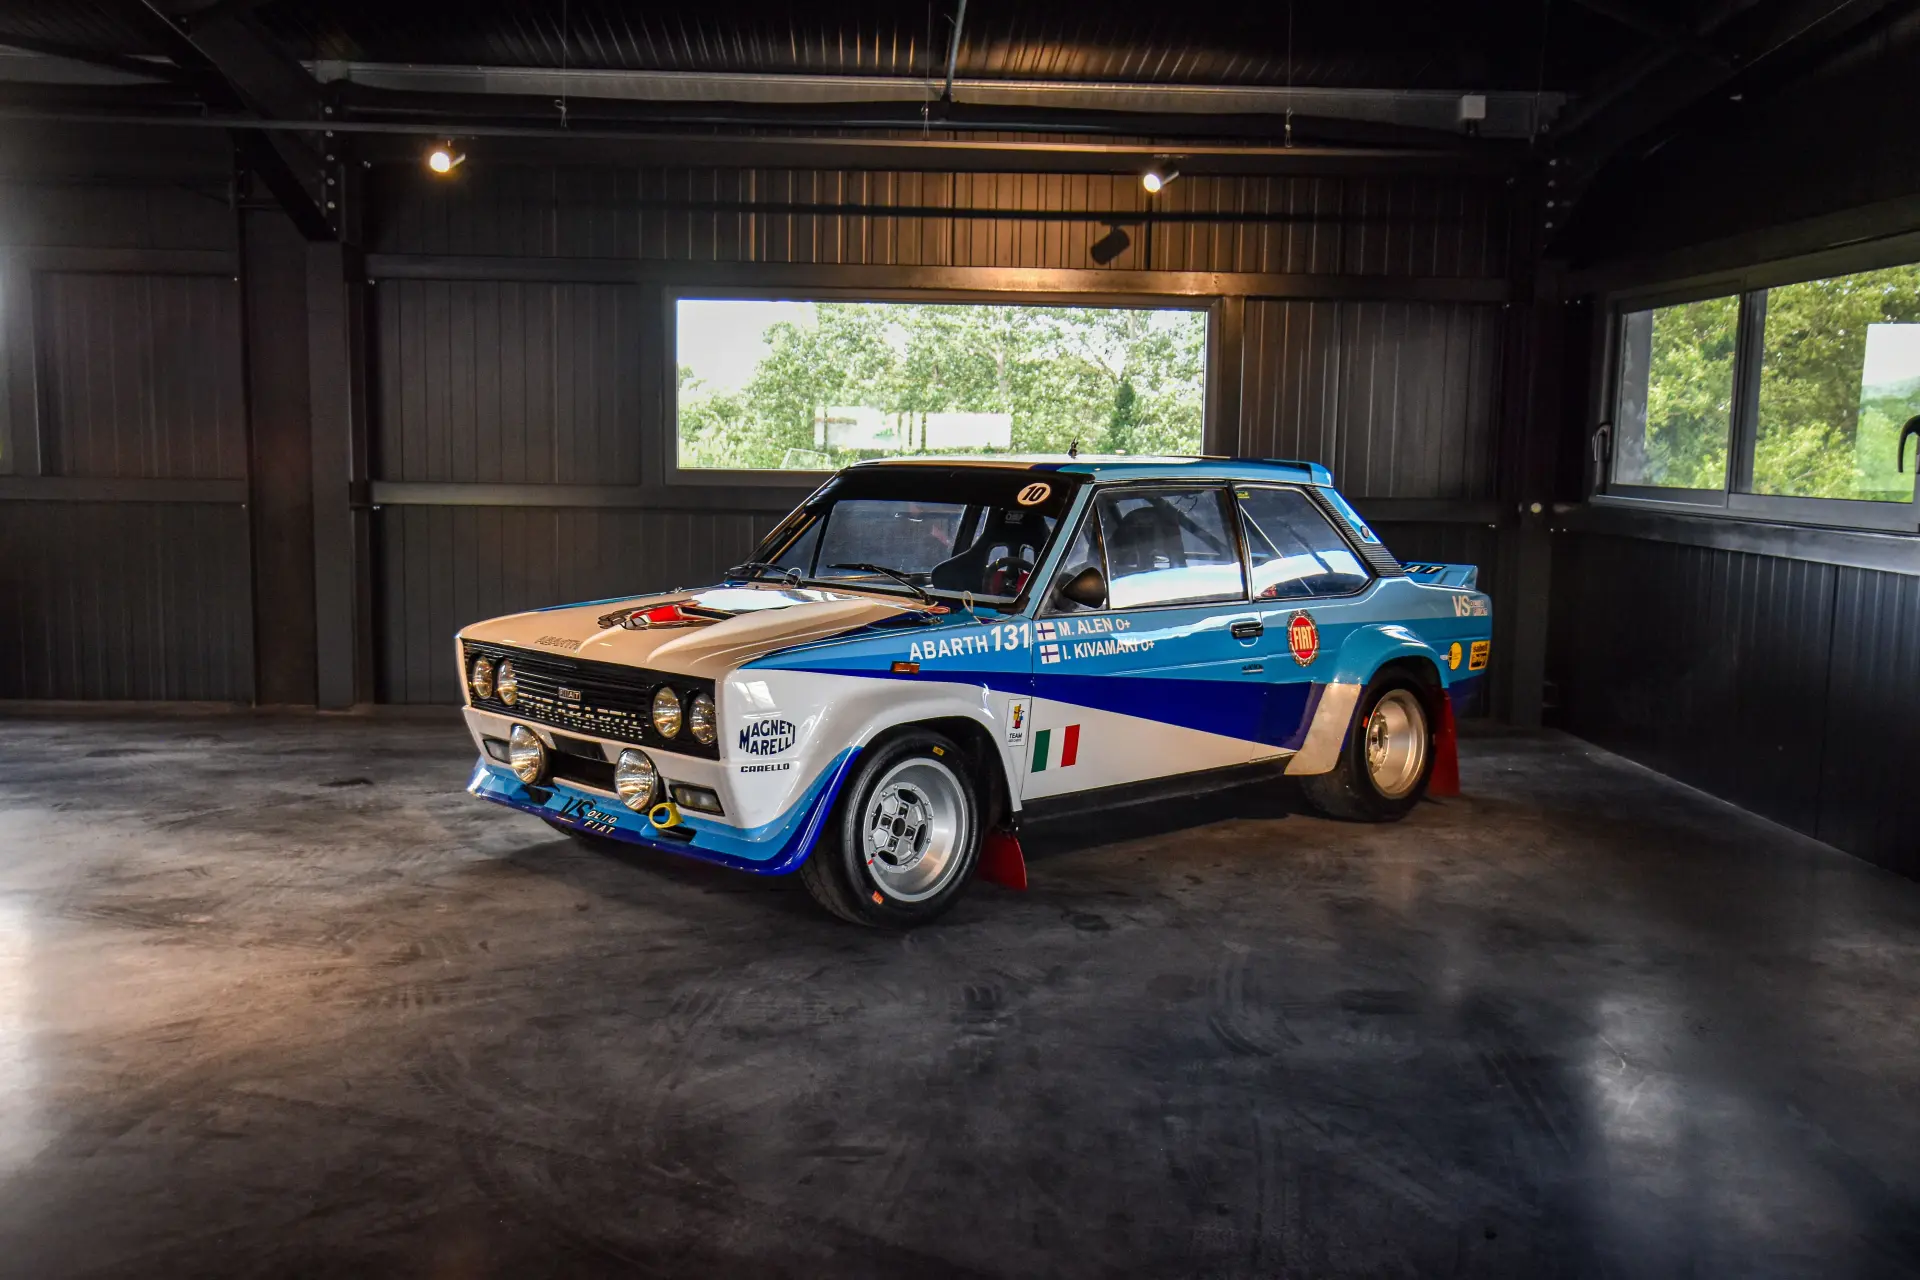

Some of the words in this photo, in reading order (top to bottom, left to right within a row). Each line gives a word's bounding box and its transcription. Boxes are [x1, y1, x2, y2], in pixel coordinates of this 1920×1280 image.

[1022, 486, 1047, 501] 10
[1452, 595, 1471, 617] VS
[1058, 621, 1075, 637] M.
[1078, 618, 1113, 635] ALEN
[909, 635, 989, 661] ABARTH
[991, 623, 1029, 652] 131
[1293, 625, 1313, 650] FIAT
[559, 688, 580, 700] FIAT
[739, 719, 796, 745] MAGNETI
[739, 731, 796, 756] MARELLI
[740, 762, 790, 773] CARELLO
[587, 809, 619, 825] OLIO
[583, 820, 616, 835] FIAT
